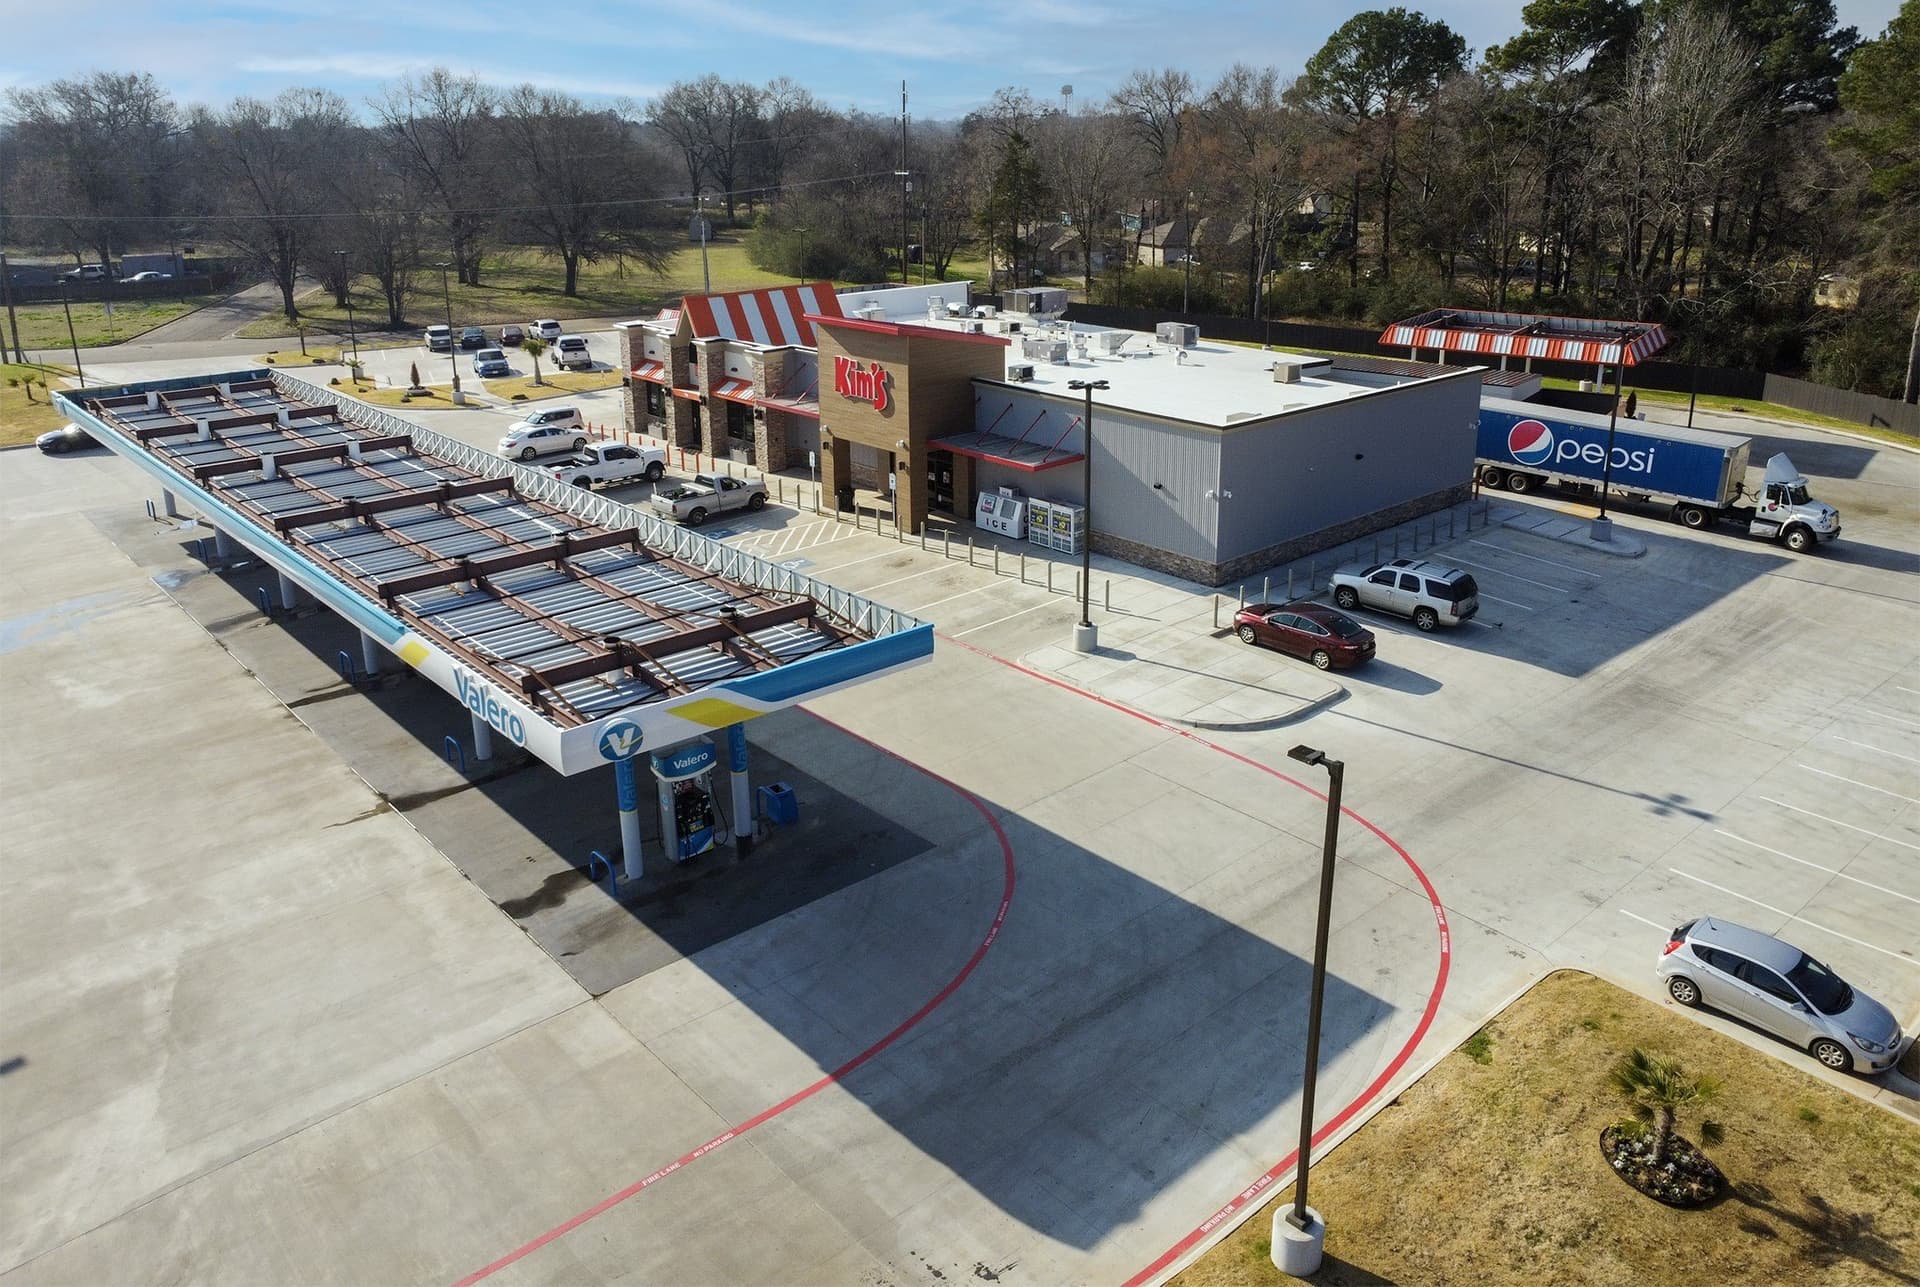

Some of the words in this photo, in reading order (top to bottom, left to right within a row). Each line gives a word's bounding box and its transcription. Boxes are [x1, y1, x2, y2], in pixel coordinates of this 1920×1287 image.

[835, 356, 887, 411] Kim's
[1556, 439, 1655, 473] pepsi
[986, 518, 1007, 531] ICE
[453, 668, 525, 744] Valero
[673, 752, 708, 769] Valero
[660, 1162, 681, 1176] LANE
[693, 1149, 704, 1158] NO
[703, 1132, 734, 1152] PARKING
[1241, 1184, 1260, 1199] LANE
